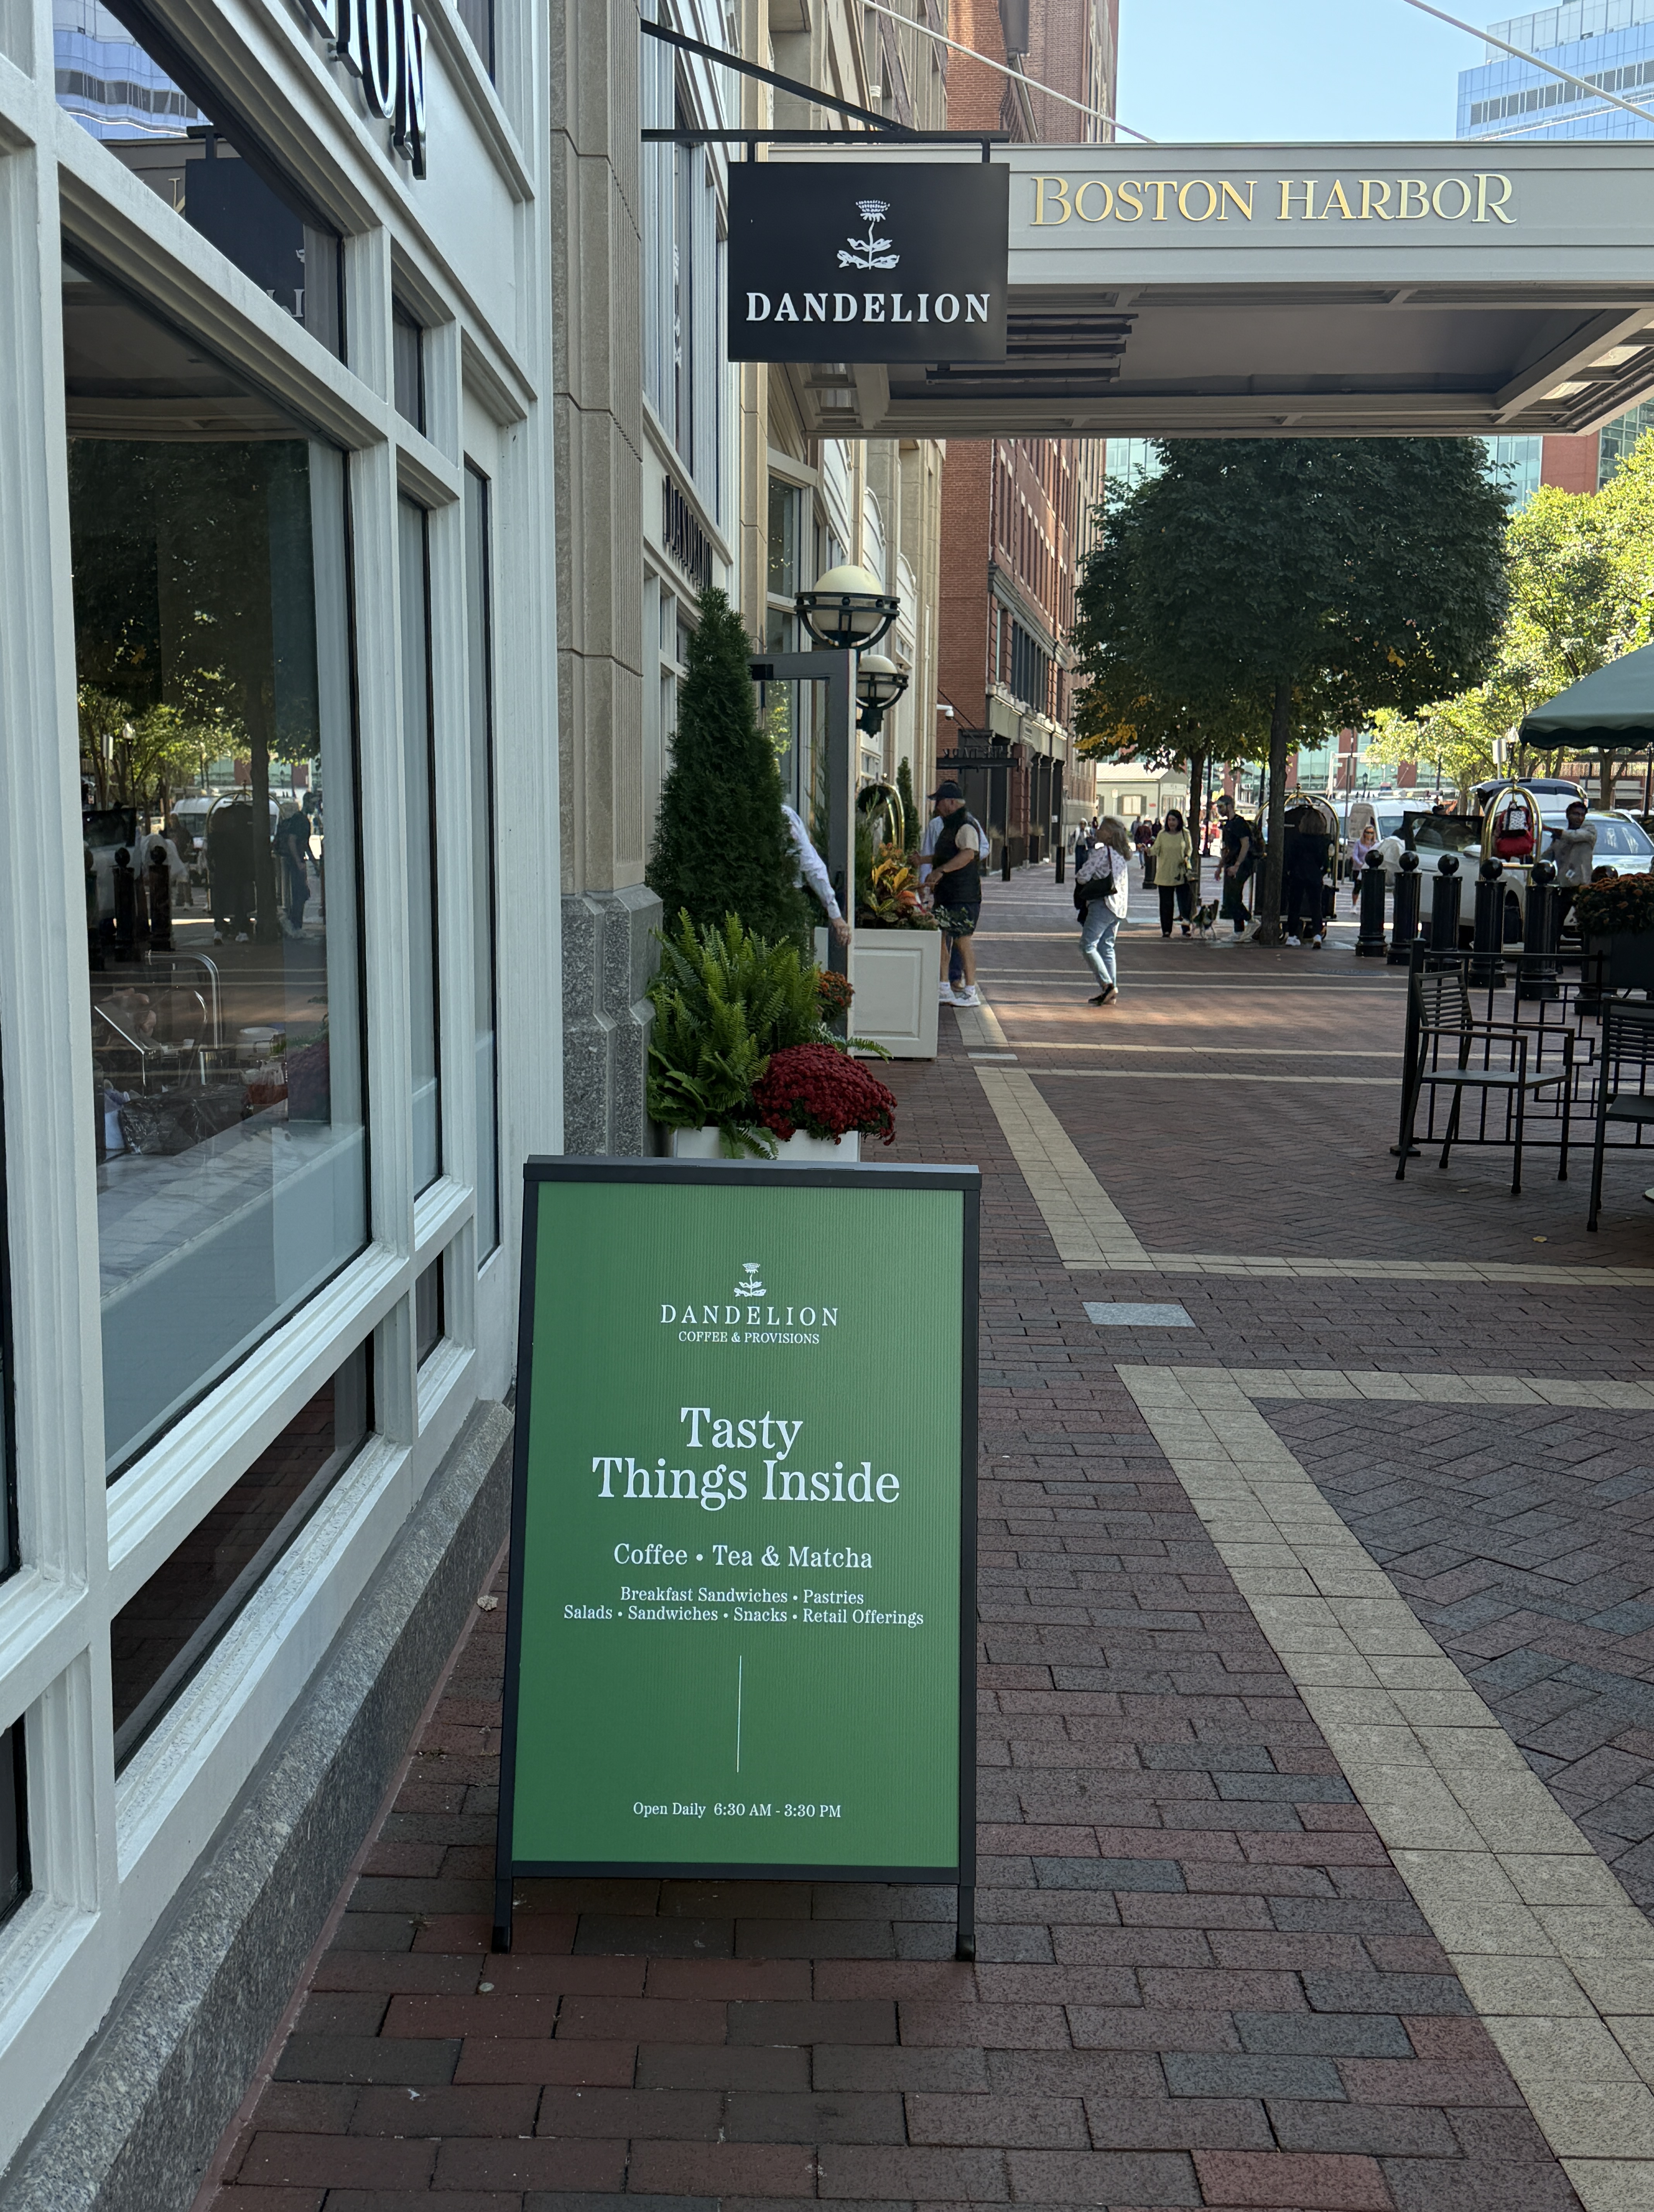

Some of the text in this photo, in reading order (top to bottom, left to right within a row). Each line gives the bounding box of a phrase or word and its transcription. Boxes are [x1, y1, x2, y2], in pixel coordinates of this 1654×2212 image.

[1031, 174, 1517, 226] BOSTON HARBOR
[746, 292, 991, 323] DANDELION
[660, 1304, 839, 1326] DANDELION
[678, 1331, 820, 1345] COFFEE & PROVISIONS
[680, 1407, 804, 1460] Tasty
[592, 1456, 900, 1511] Things Inside
[614, 1543, 873, 1569] Coffee Tea & Matcha
[620, 1586, 864, 1605] Breakfast Sandwiches Pastries
[564, 1604, 924, 1628] Salads Sandwiches Snacks Retail Offerings
[633, 1802, 668, 1818] Open
[672, 1802, 707, 1819] Daily
[714, 1802, 746, 1816] 6:30
[748, 1803, 772, 1817] AM
[784, 1803, 816, 1817] 3:30
[819, 1804, 841, 1818] PM
